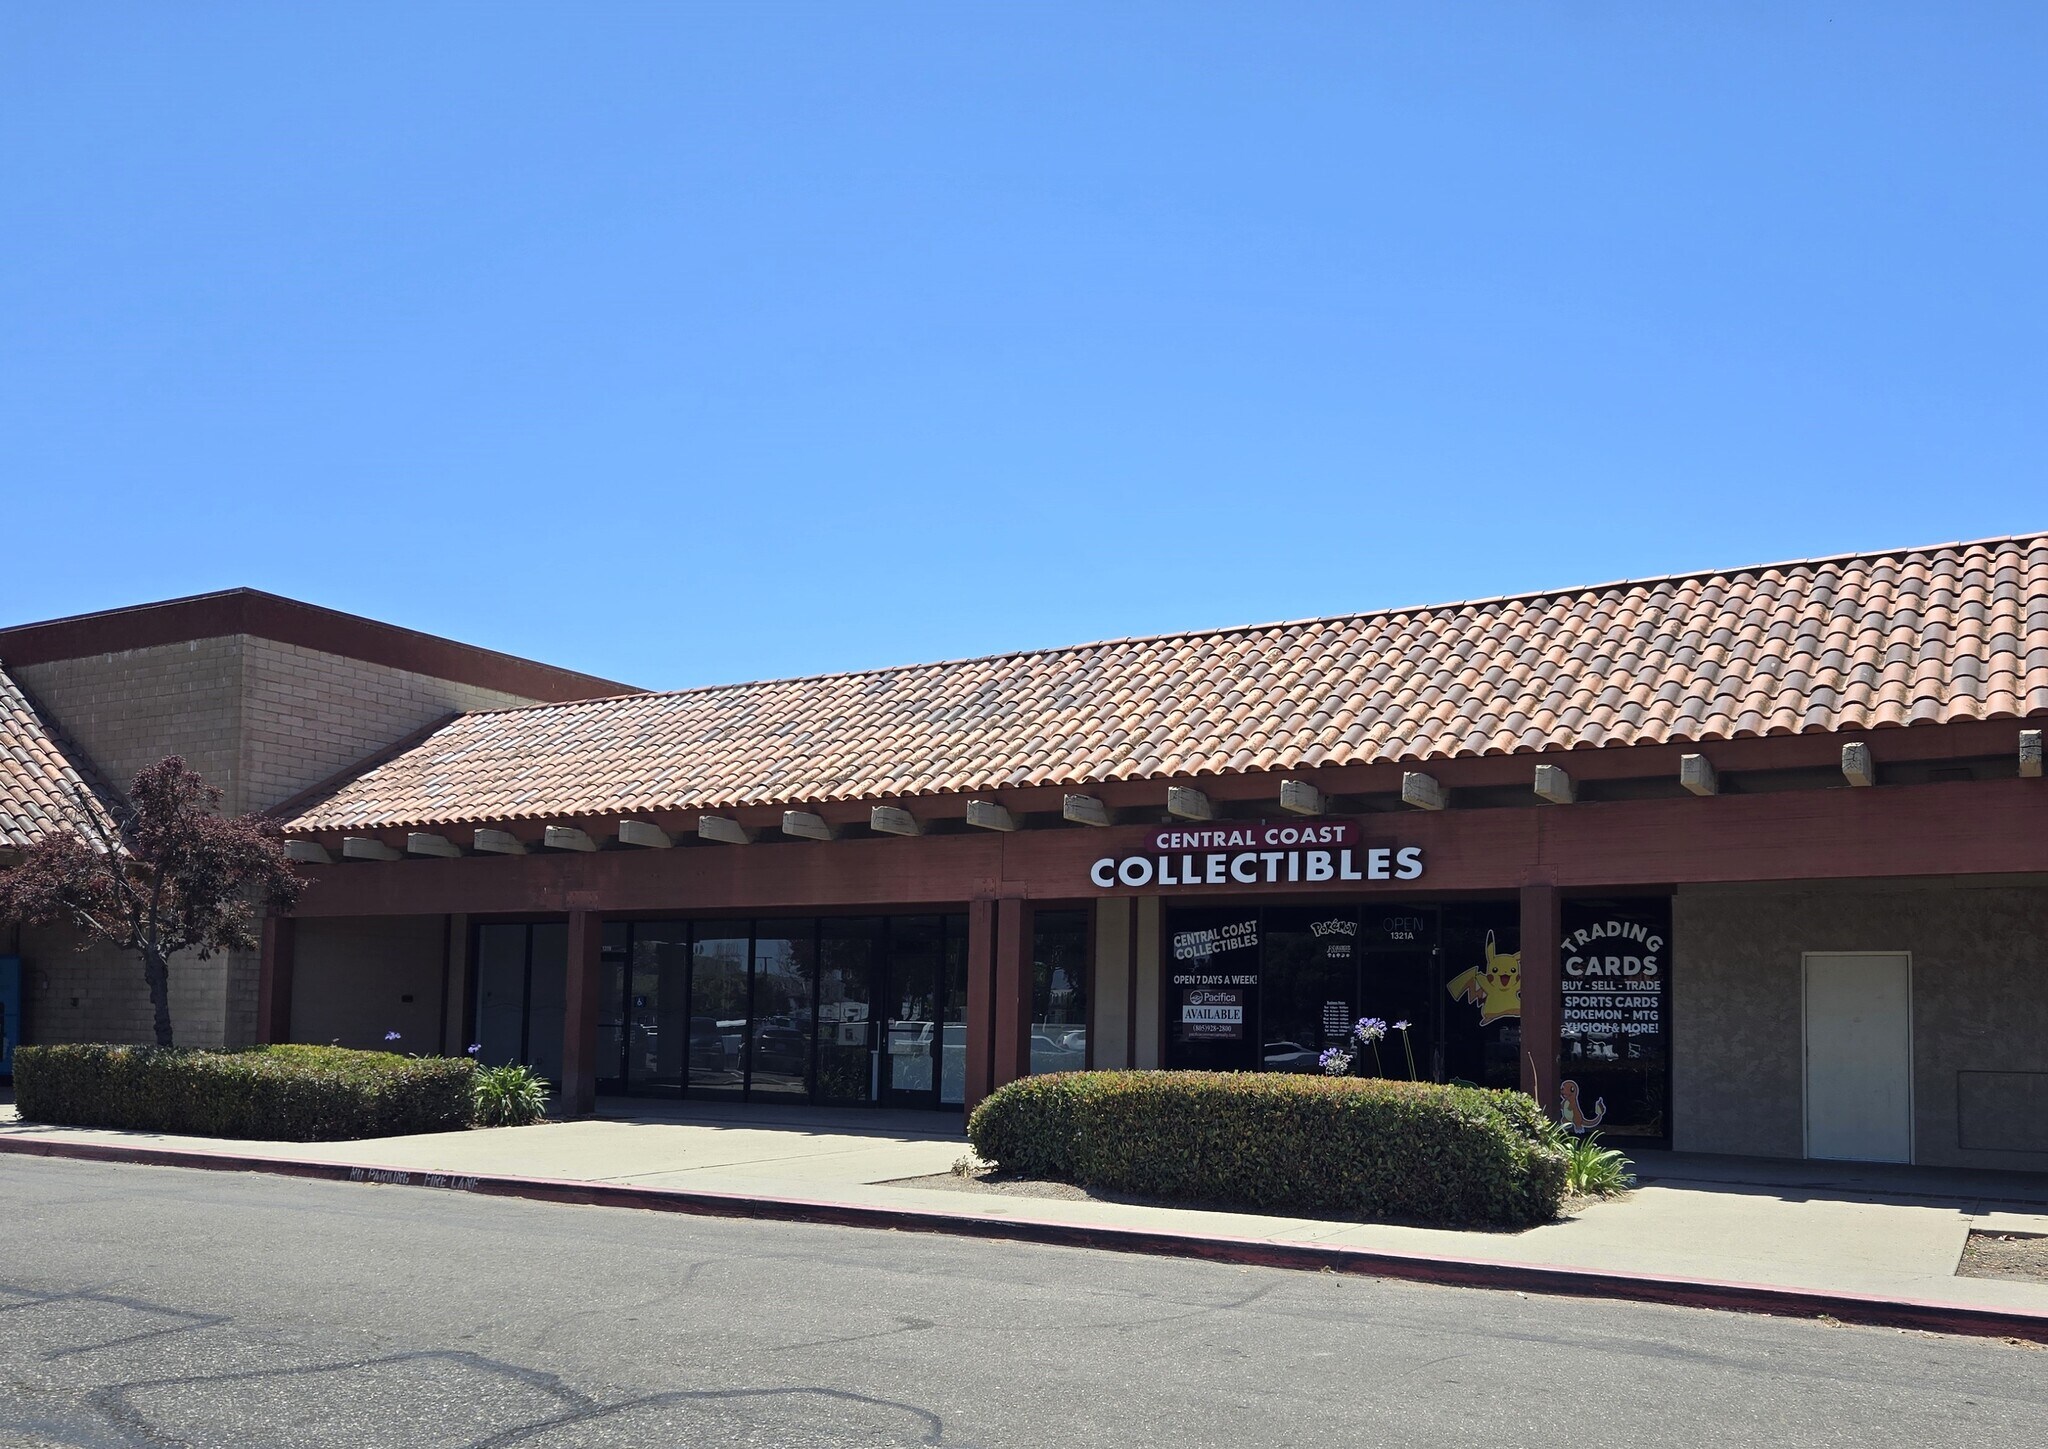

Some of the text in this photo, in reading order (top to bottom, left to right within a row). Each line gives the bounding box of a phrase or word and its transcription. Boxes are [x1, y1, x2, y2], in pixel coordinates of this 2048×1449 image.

[1156, 826, 1346, 849] CENTRAL COAST
[1090, 847, 1424, 887] COLLECTIBLES
[1383, 917, 1424, 932] OPEN
[1174, 920, 1258, 949] CENTRAL COAST
[1390, 932, 1414, 940] 1321A
[1561, 921, 1664, 953] TRADING
[1175, 934, 1258, 960] COLLECTIBLES
[1566, 956, 1658, 976] CARDS
[1173, 975, 1258, 985] OPEN 7 DAYS A WEEK!
[1562, 981, 1584, 991] BUY
[1591, 981, 1616, 991] SELL
[1625, 981, 1661, 991] TRADE
[1204, 992, 1236, 1002] Pacifica
[1565, 997, 1659, 1007] SPORTS CARDS
[1185, 1009, 1241, 1020] AVAILABLE
[1564, 1009, 1622, 1020] POKEMON
[1632, 1010, 1659, 1021] MTG
[1565, 1022, 1659, 1033] YUGIOH & MORE!
[350, 1167, 364, 1181] NO
[367, 1168, 410, 1184] PARKING
[423, 1172, 447, 1187] FIRE
